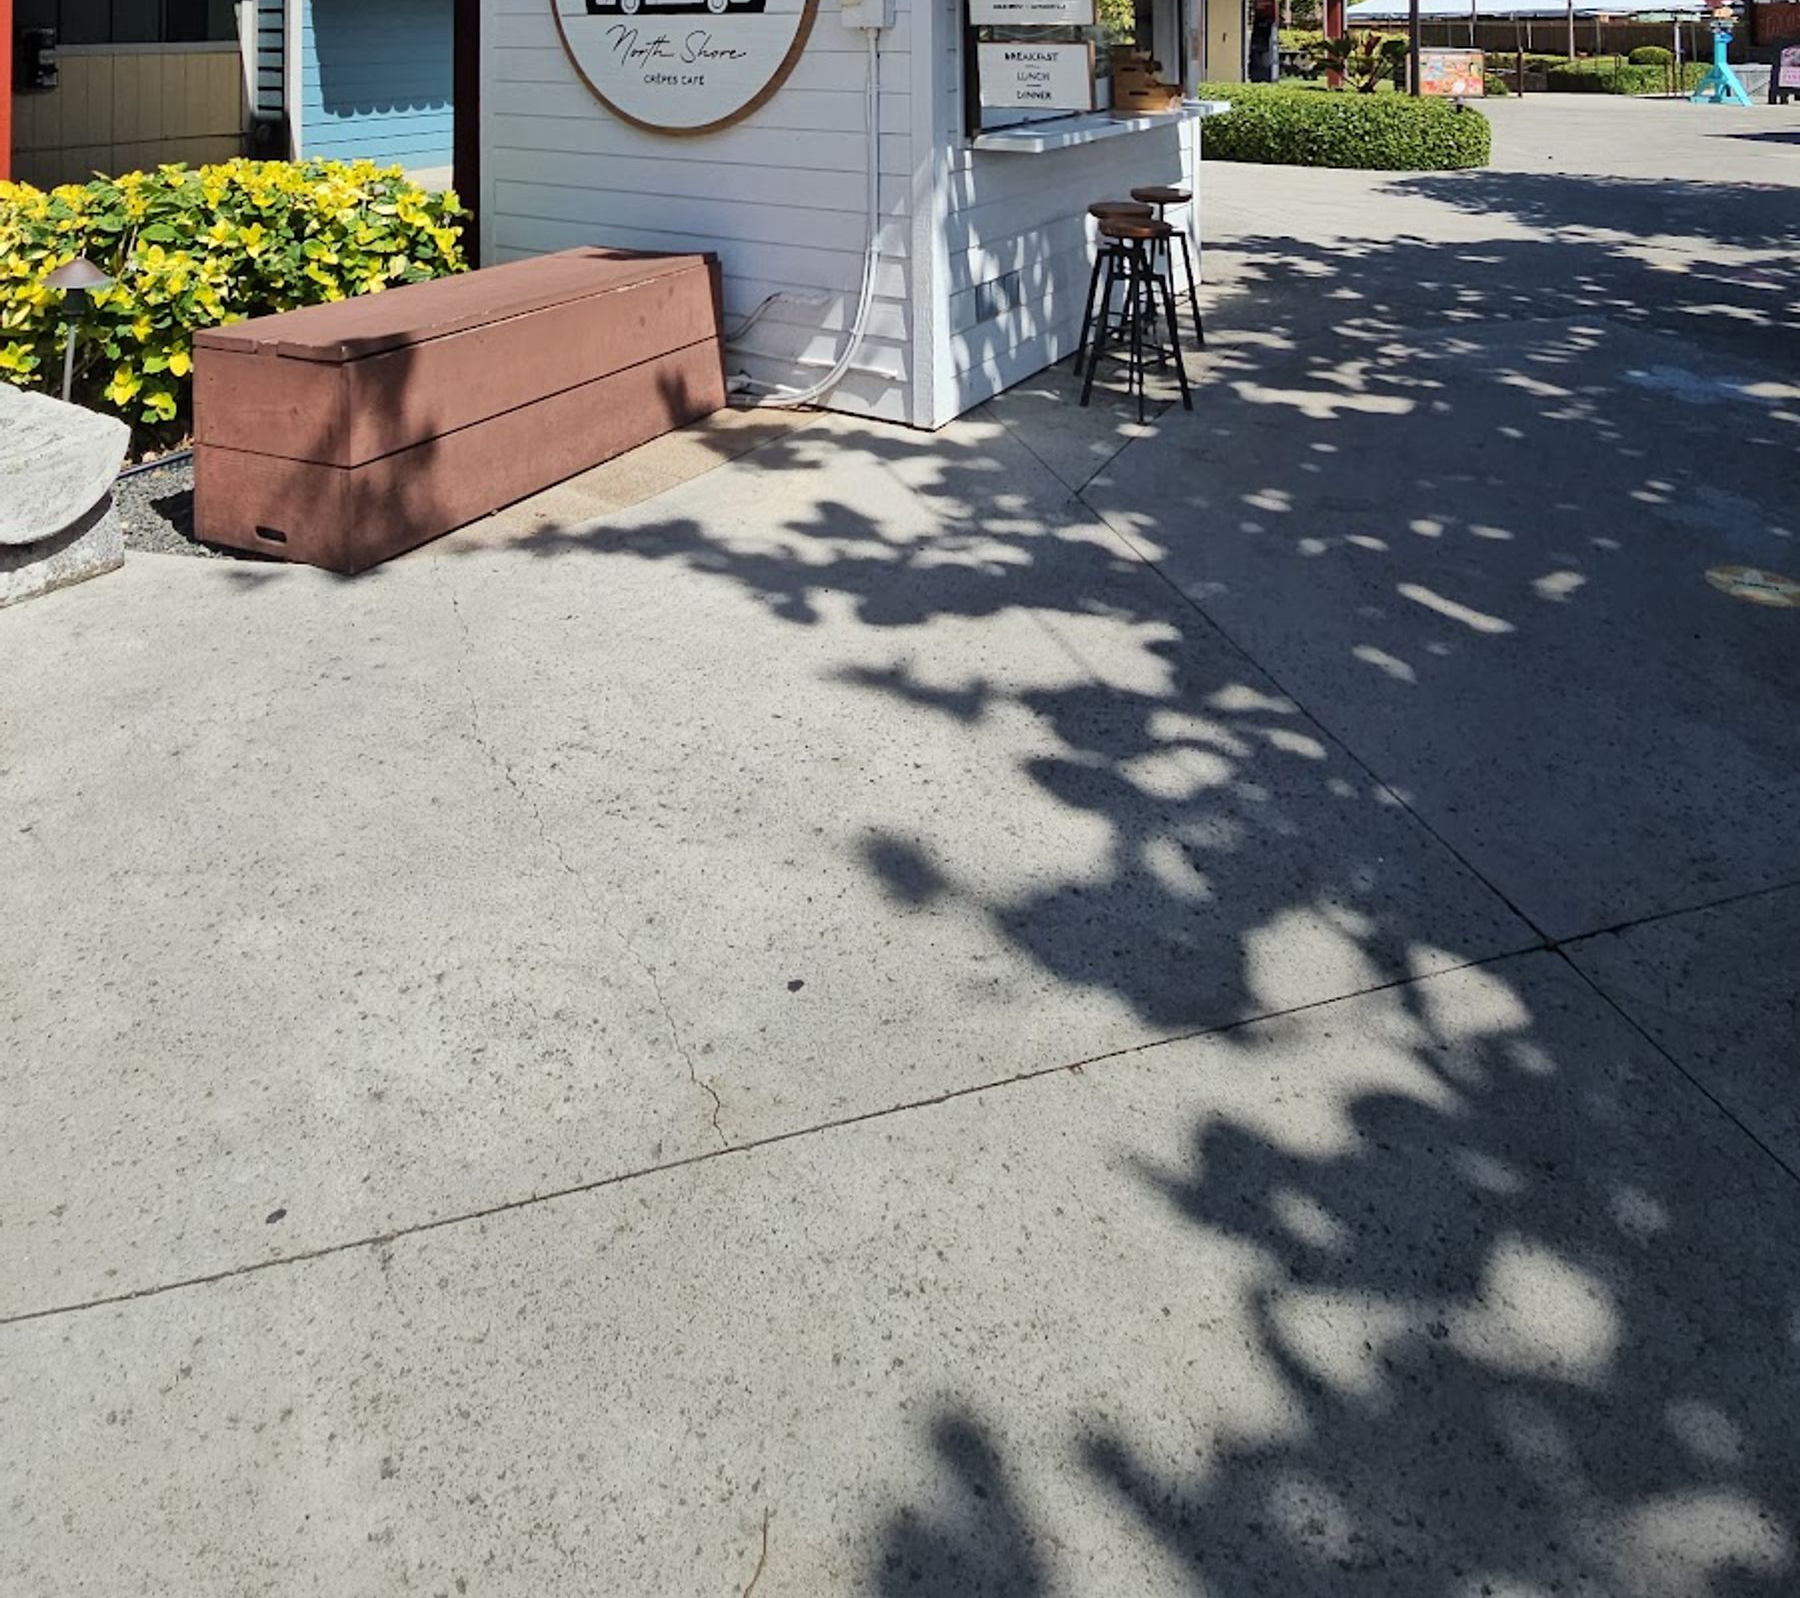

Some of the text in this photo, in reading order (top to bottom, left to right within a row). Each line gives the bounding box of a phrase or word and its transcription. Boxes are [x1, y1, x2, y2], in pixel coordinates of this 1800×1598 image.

[605, 24, 748, 70] North Shore
[1005, 51, 1060, 62] BREAKFAST
[1016, 71, 1051, 82] LUNCH
[1016, 89, 1052, 100] DINNER
